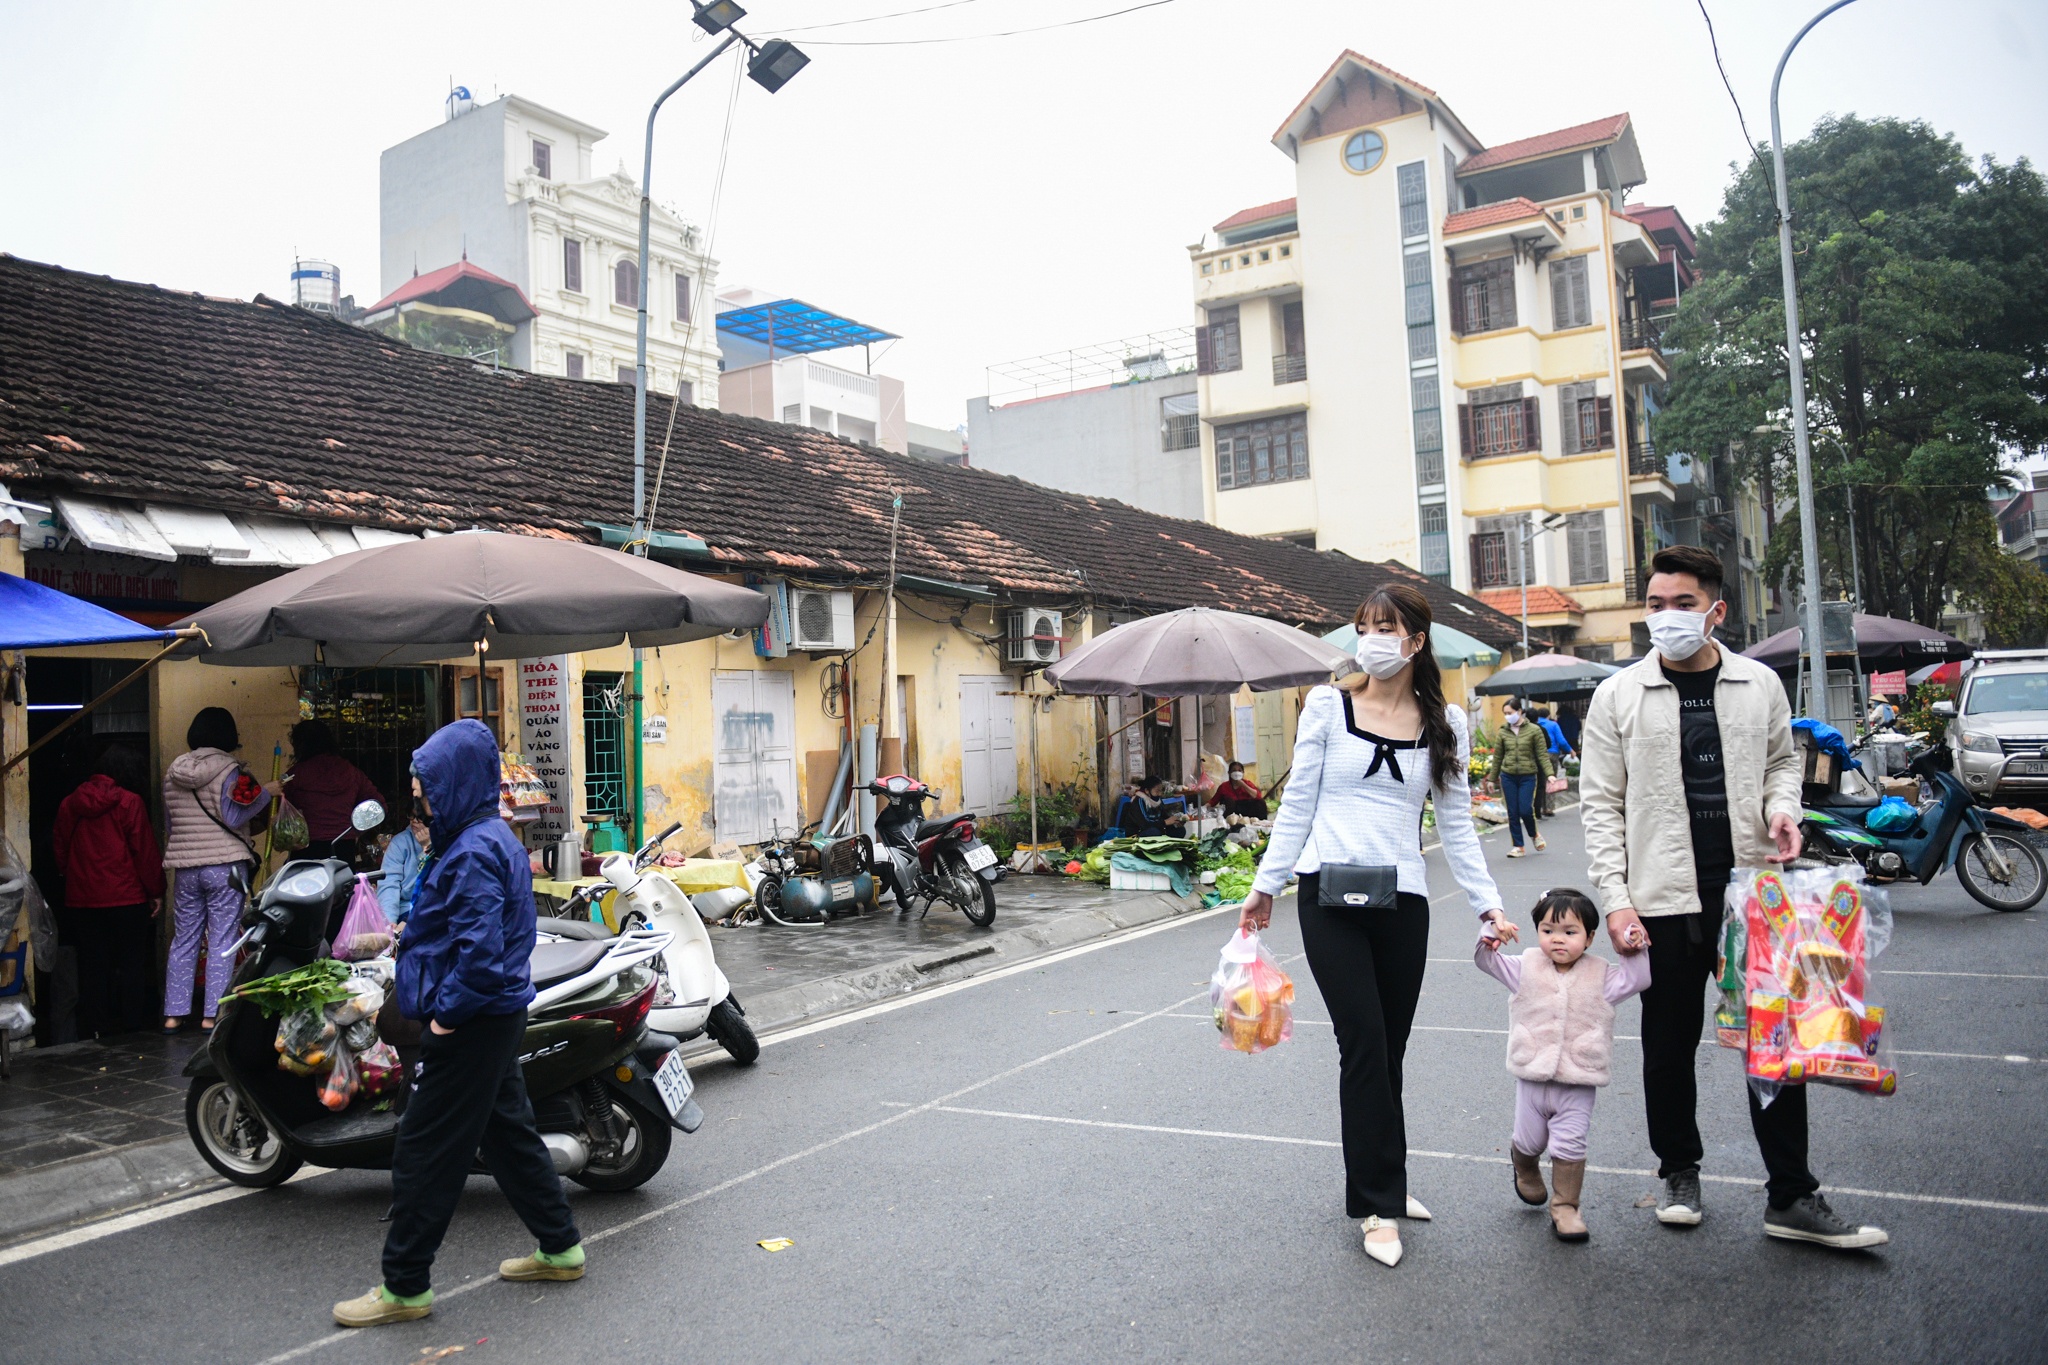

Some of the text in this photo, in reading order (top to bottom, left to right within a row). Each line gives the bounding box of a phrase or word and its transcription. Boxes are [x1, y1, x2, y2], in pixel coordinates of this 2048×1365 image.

[523, 661, 559, 673] HÓA
[525, 674, 558, 688] THẺ
[528, 689, 556, 701] ĐIỆN
[524, 704, 560, 713] THOẠI
[535, 728, 551, 738] ÁO
[536, 753, 552, 763] MÃ
[1699, 753, 1716, 762] MY
[537, 767, 566, 776] ƯƠNG
[1695, 810, 1727, 819] STEPS
[549, 821, 562, 829] GA
[545, 834, 562, 843] LỊCH
[718, 848, 737, 859] Schneider
[518, 1040, 568, 1064] EAD
[659, 1056, 683, 1092] 30-K2
[668, 1073, 692, 1112] 7221
